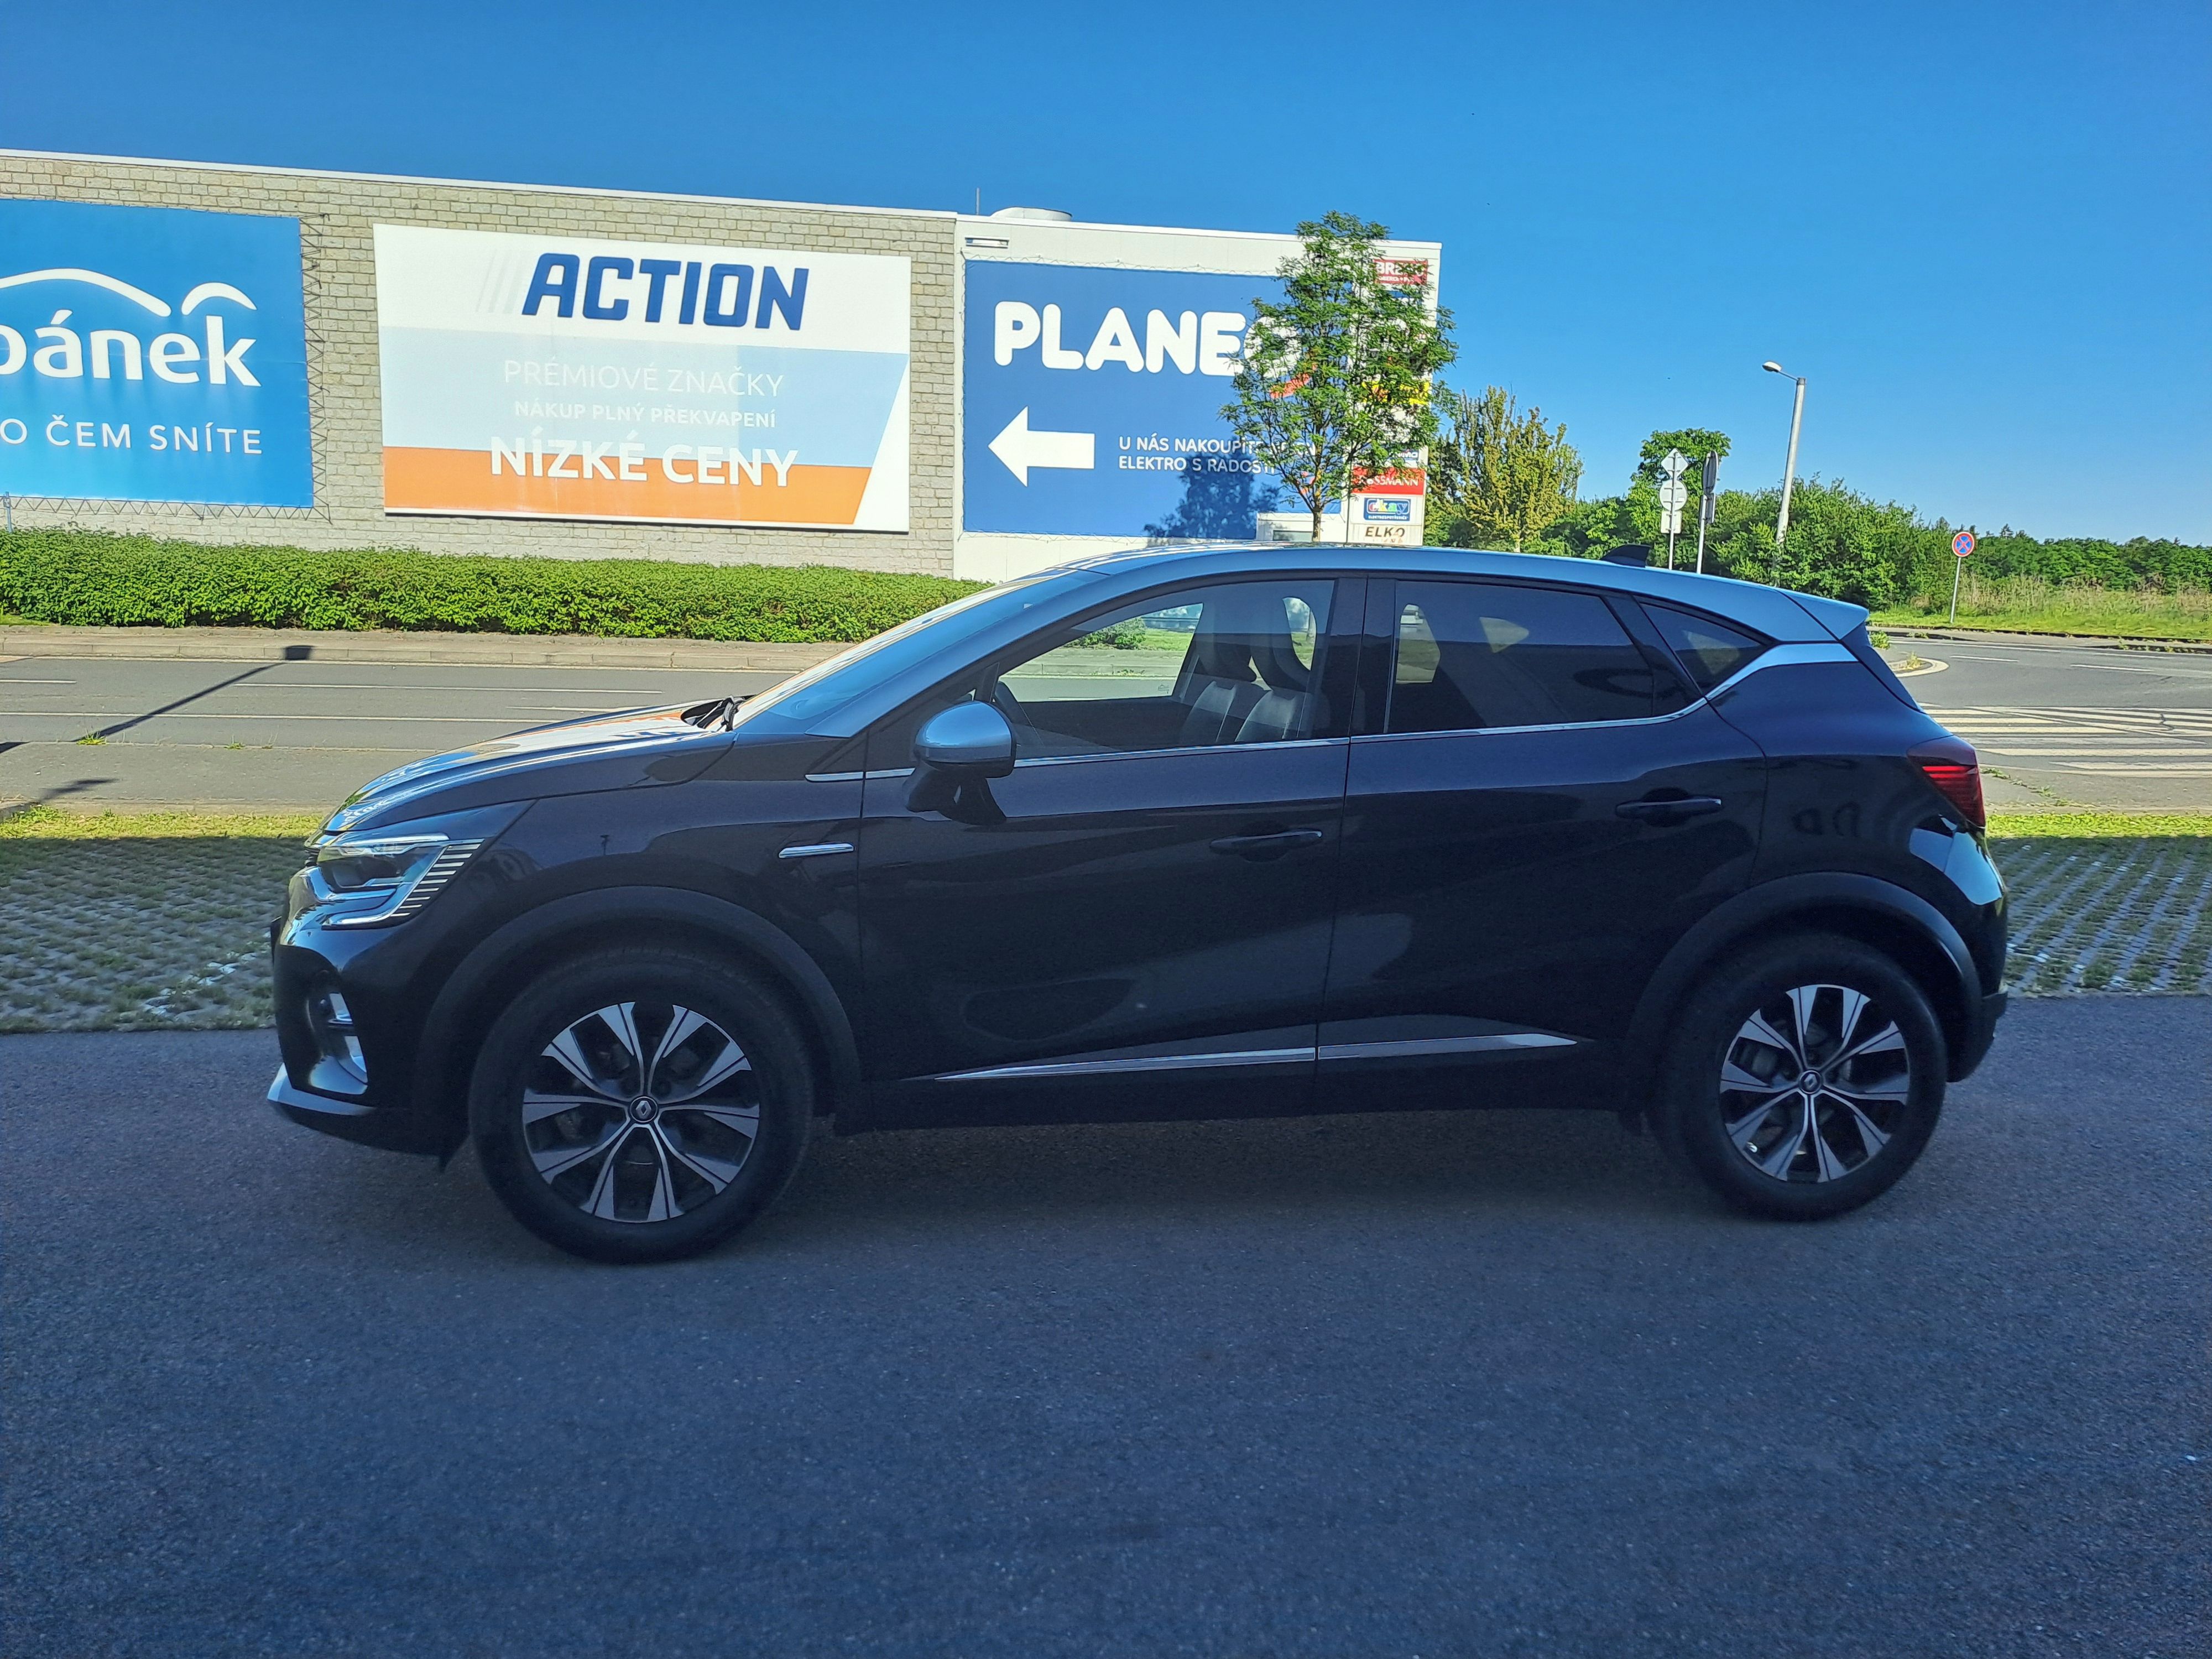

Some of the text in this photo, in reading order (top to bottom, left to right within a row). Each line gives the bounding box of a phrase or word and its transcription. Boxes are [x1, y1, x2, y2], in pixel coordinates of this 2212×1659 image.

[521, 253, 809, 331] ACTION
[504, 357, 784, 397] PRÉMIOVÉ ZNAČKY
[514, 398, 776, 428] NÁKUP PLNÝ PŘEKVAPENÍ
[0, 414, 263, 455] O ČEM SNÍTE
[1119, 436, 1131, 451] U
[1136, 432, 1170, 452] NÁS
[490, 425, 799, 488] NÍZKÉ CENY
[1118, 455, 1187, 471] ELEKTRO
[1192, 457, 1202, 472] S
